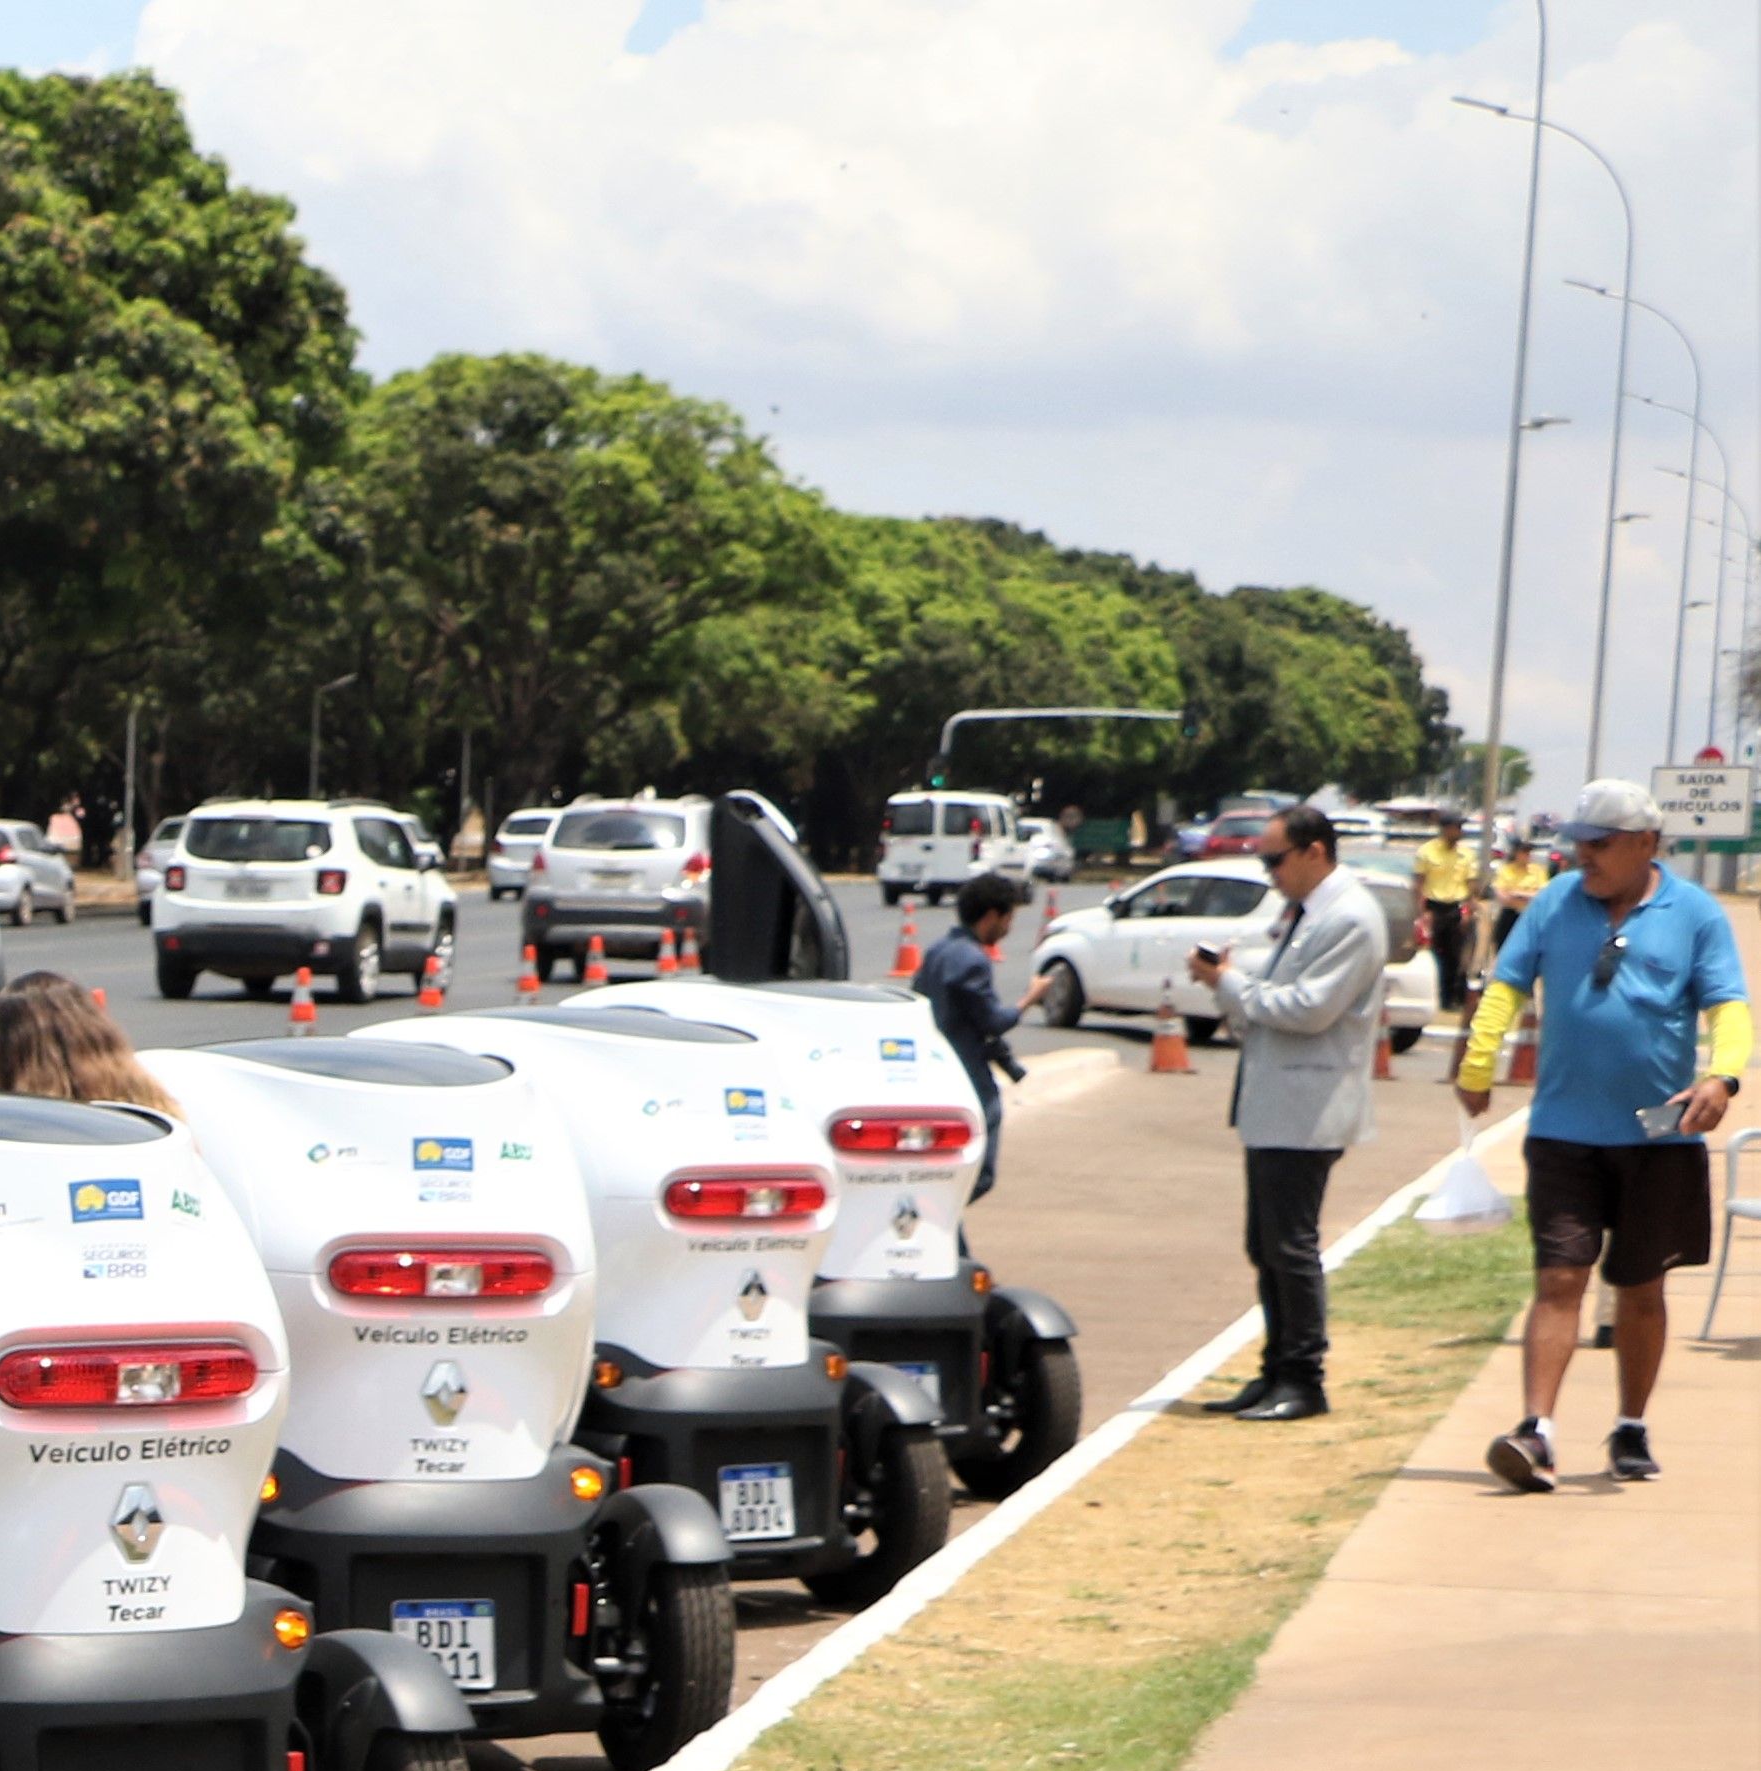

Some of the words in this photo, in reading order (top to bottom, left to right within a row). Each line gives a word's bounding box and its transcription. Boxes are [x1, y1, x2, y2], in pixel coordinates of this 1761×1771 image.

[354, 1326, 439, 1344] Veículo
[447, 1325, 528, 1344] Elétrico
[30, 1441, 131, 1463] Veículo
[140, 1436, 231, 1459] Elétrico
[416, 1458, 466, 1473] Tecar
[103, 1575, 172, 1596] TWIZY
[108, 1605, 166, 1622] Tecar
[417, 1620, 471, 1648] BDI
